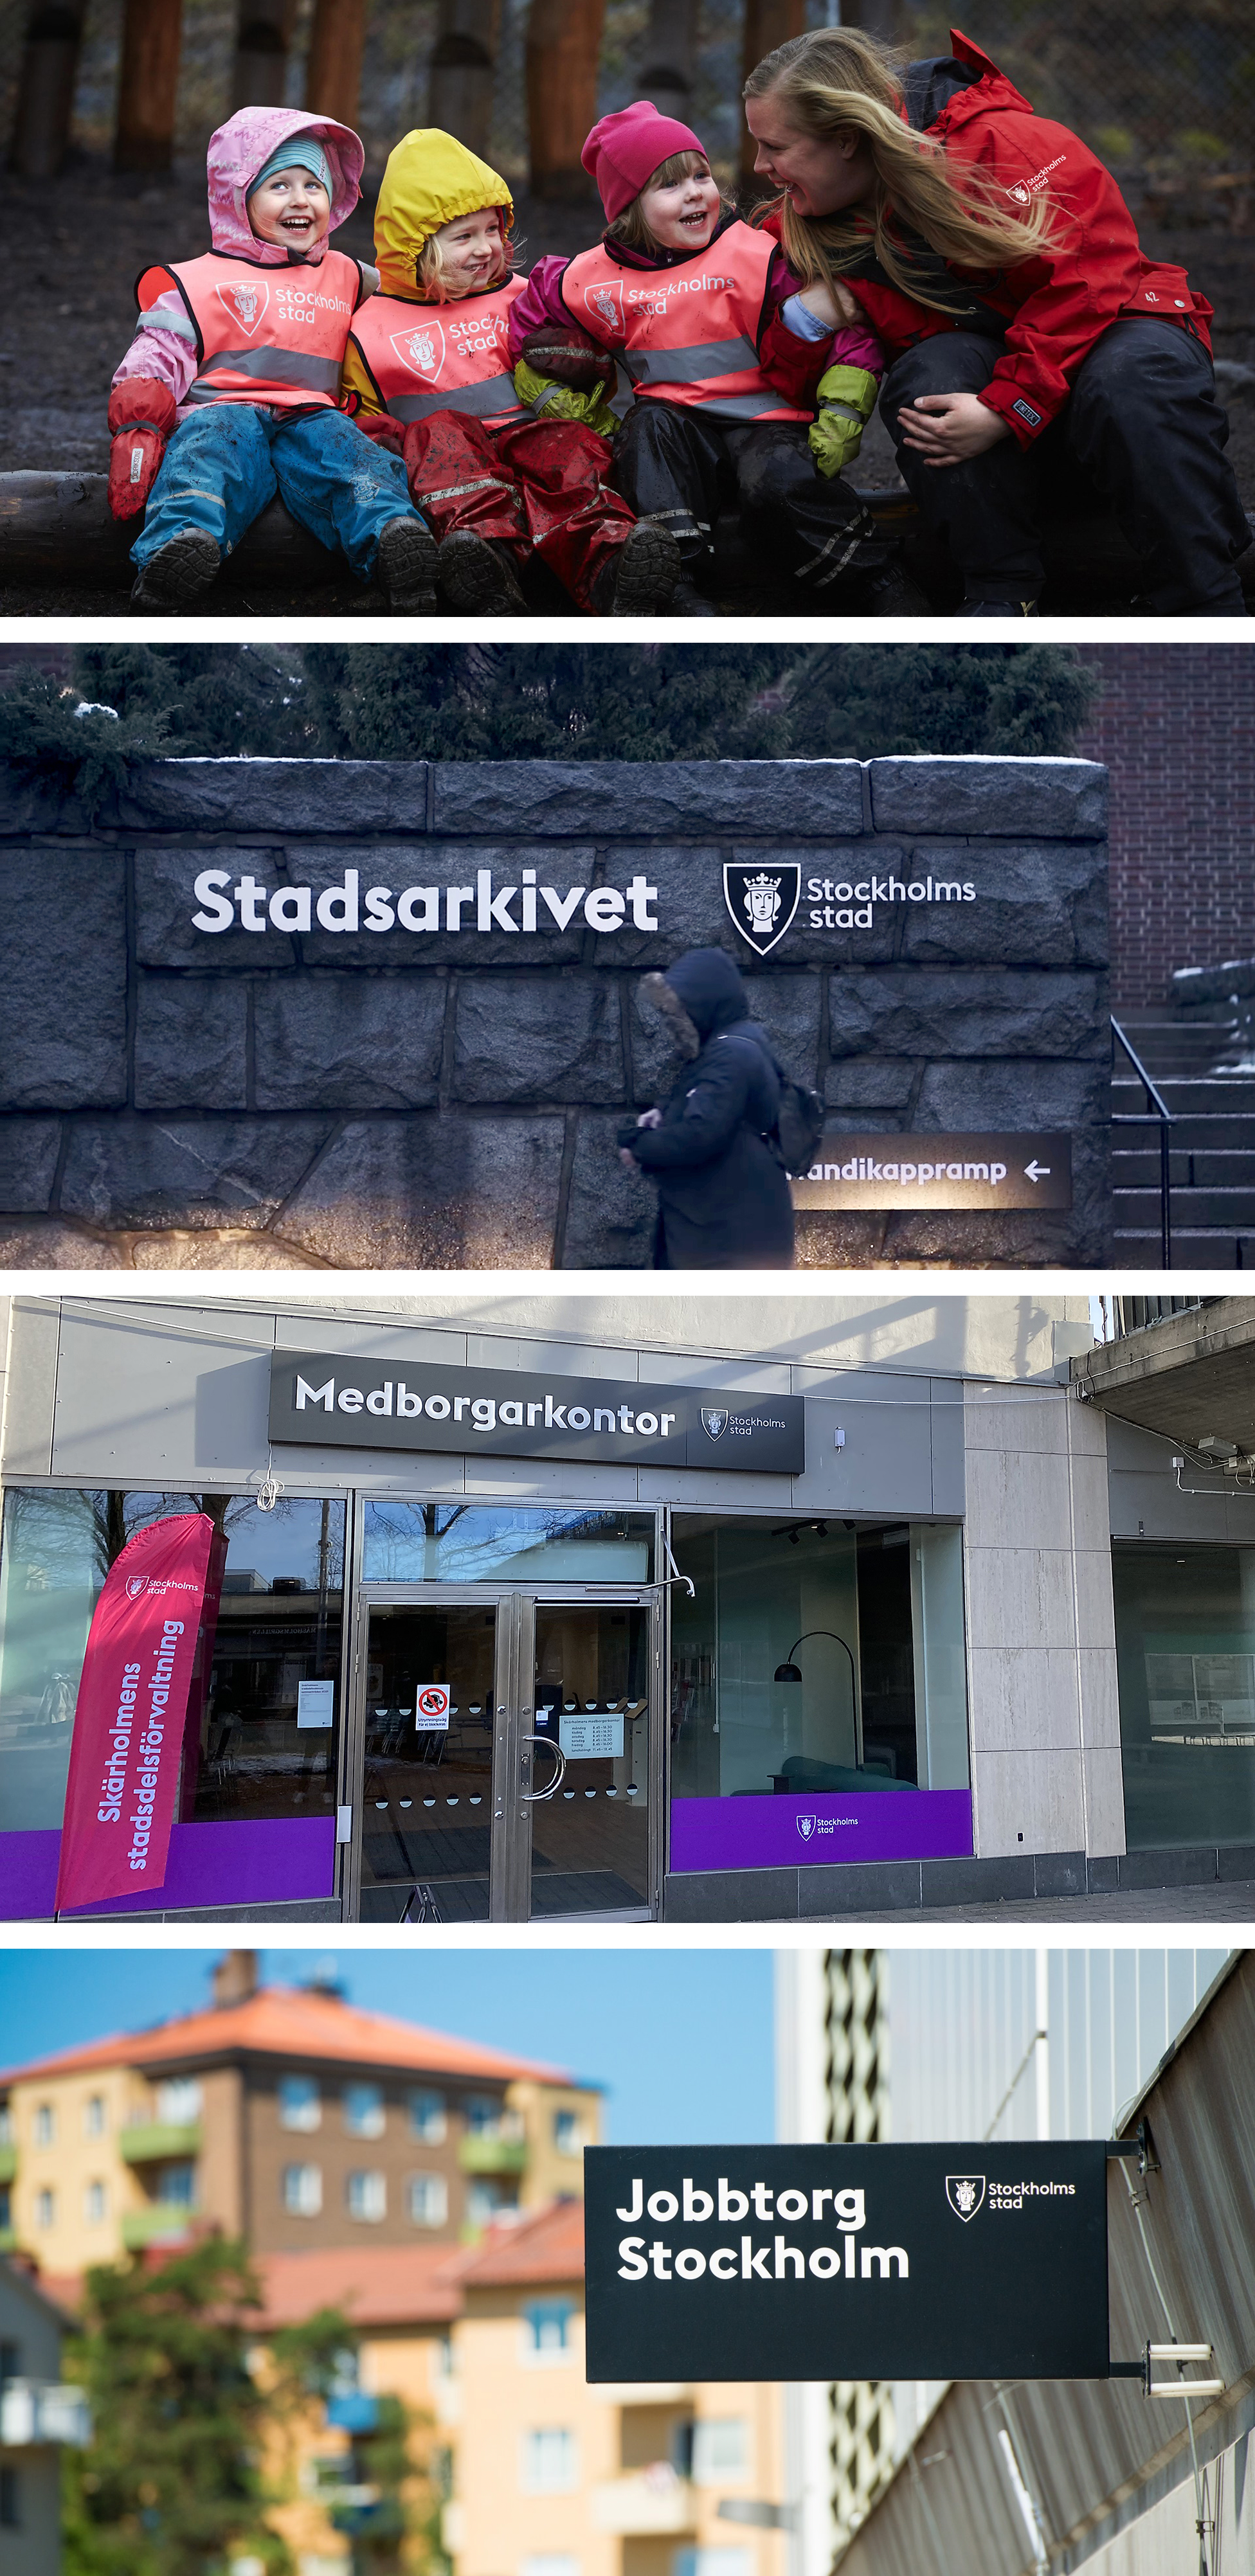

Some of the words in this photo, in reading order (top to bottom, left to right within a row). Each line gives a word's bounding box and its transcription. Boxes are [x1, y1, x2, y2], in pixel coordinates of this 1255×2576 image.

[1027, 155, 1067, 186] Stockholms
[1032, 176, 1049, 192] stad
[628, 274, 735, 303] Stockholms
[1144, 291, 1160, 303] 42
[275, 289, 352, 316] Stockholms
[278, 305, 315, 324] stad
[632, 298, 667, 316] stad
[456, 330, 498, 356] stad
[191, 868, 659, 933] Stadsarkivet
[807, 875, 977, 902] Stockholms
[809, 902, 873, 929] stad
[786, 1158, 1007, 1186] andikappramp
[295, 1373, 676, 1438] Medborgarkontor
[729, 1416, 786, 1428] Stockholms
[730, 1426, 752, 1435] stad
[149, 1580, 199, 1591] Stockholms
[97, 1662, 141, 1823] Skärholmens
[127, 1620, 185, 1870] stadsdelsförvaltning
[817, 1817, 859, 1826] Stockholms
[817, 1825, 834, 1834] stad
[988, 2182, 1076, 2196] Stockholms
[616, 2178, 866, 2231] Jobbtorg
[989, 2196, 1023, 2209] stad
[617, 2235, 909, 2280] Stockholm
